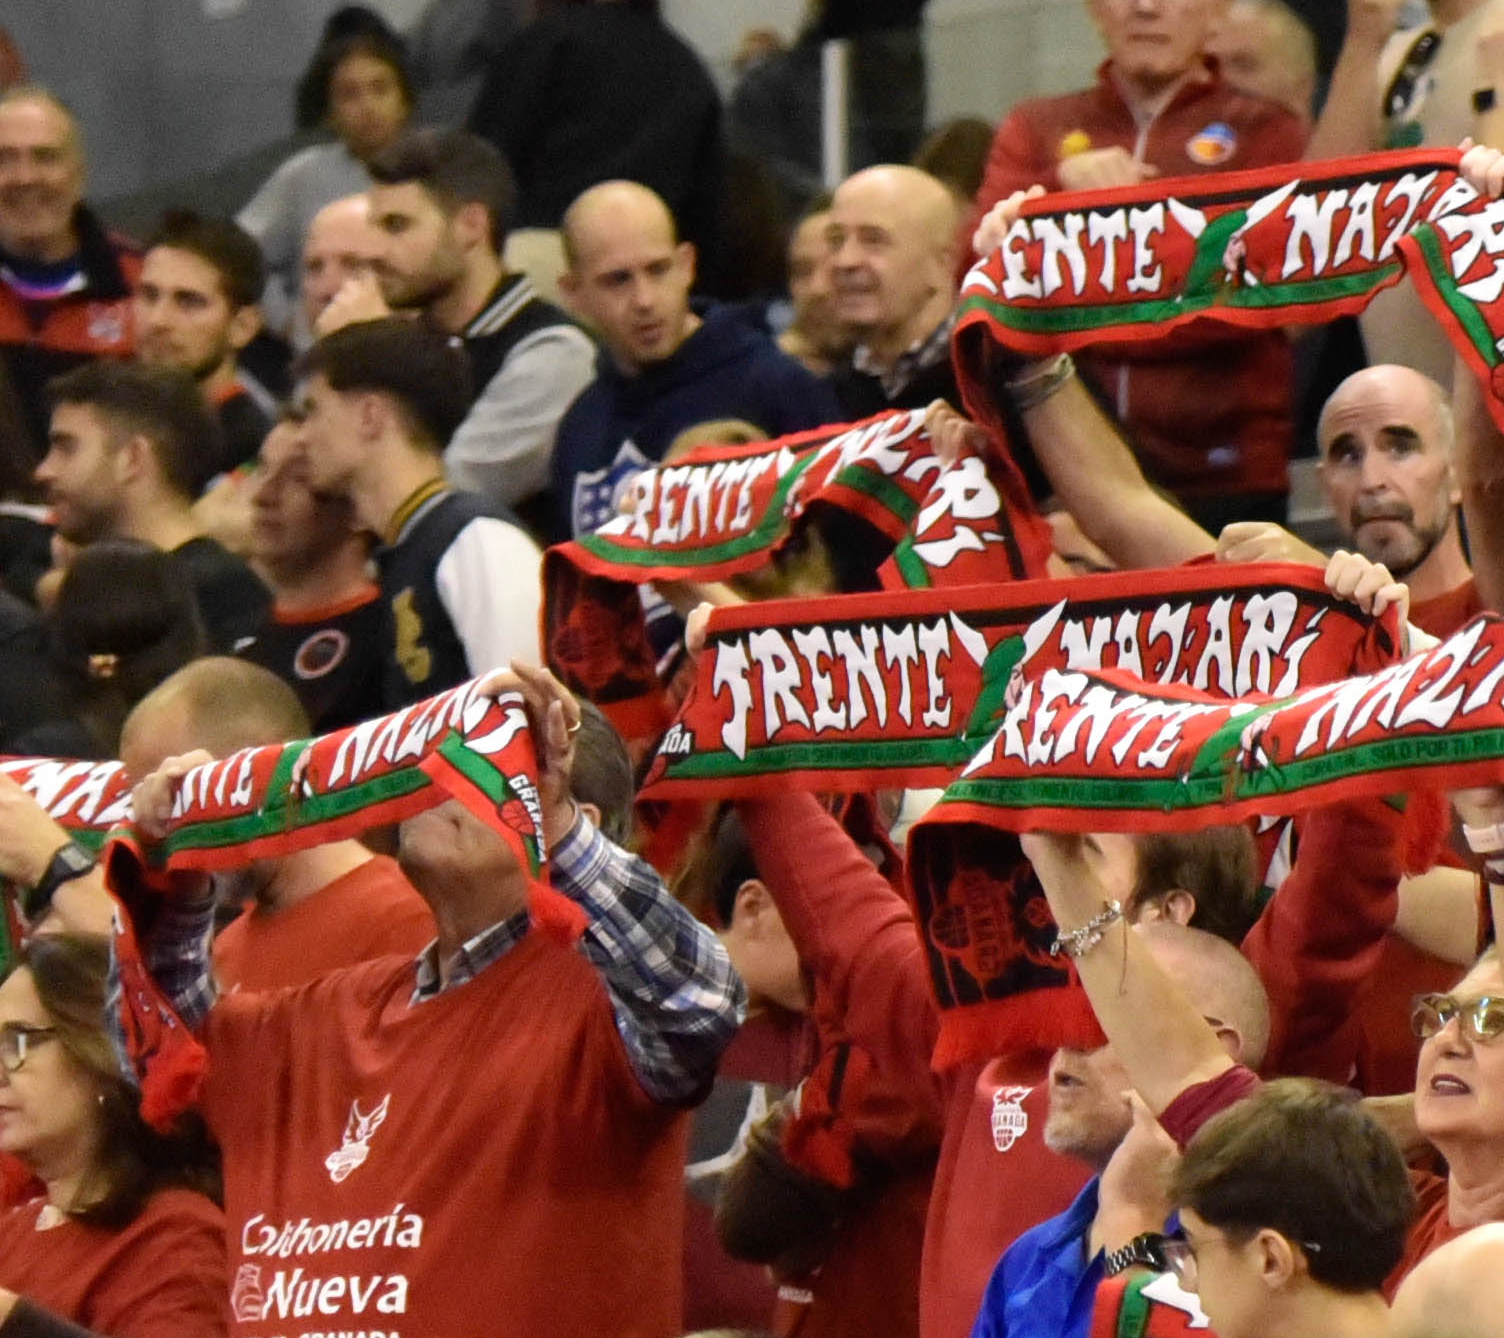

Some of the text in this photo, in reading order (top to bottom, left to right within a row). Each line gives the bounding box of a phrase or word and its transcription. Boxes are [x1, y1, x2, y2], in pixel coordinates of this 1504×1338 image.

[999, 199, 1168, 301] ENTE
[713, 615, 951, 762] FRENTE
[262, 1267, 409, 1321] Nueva
